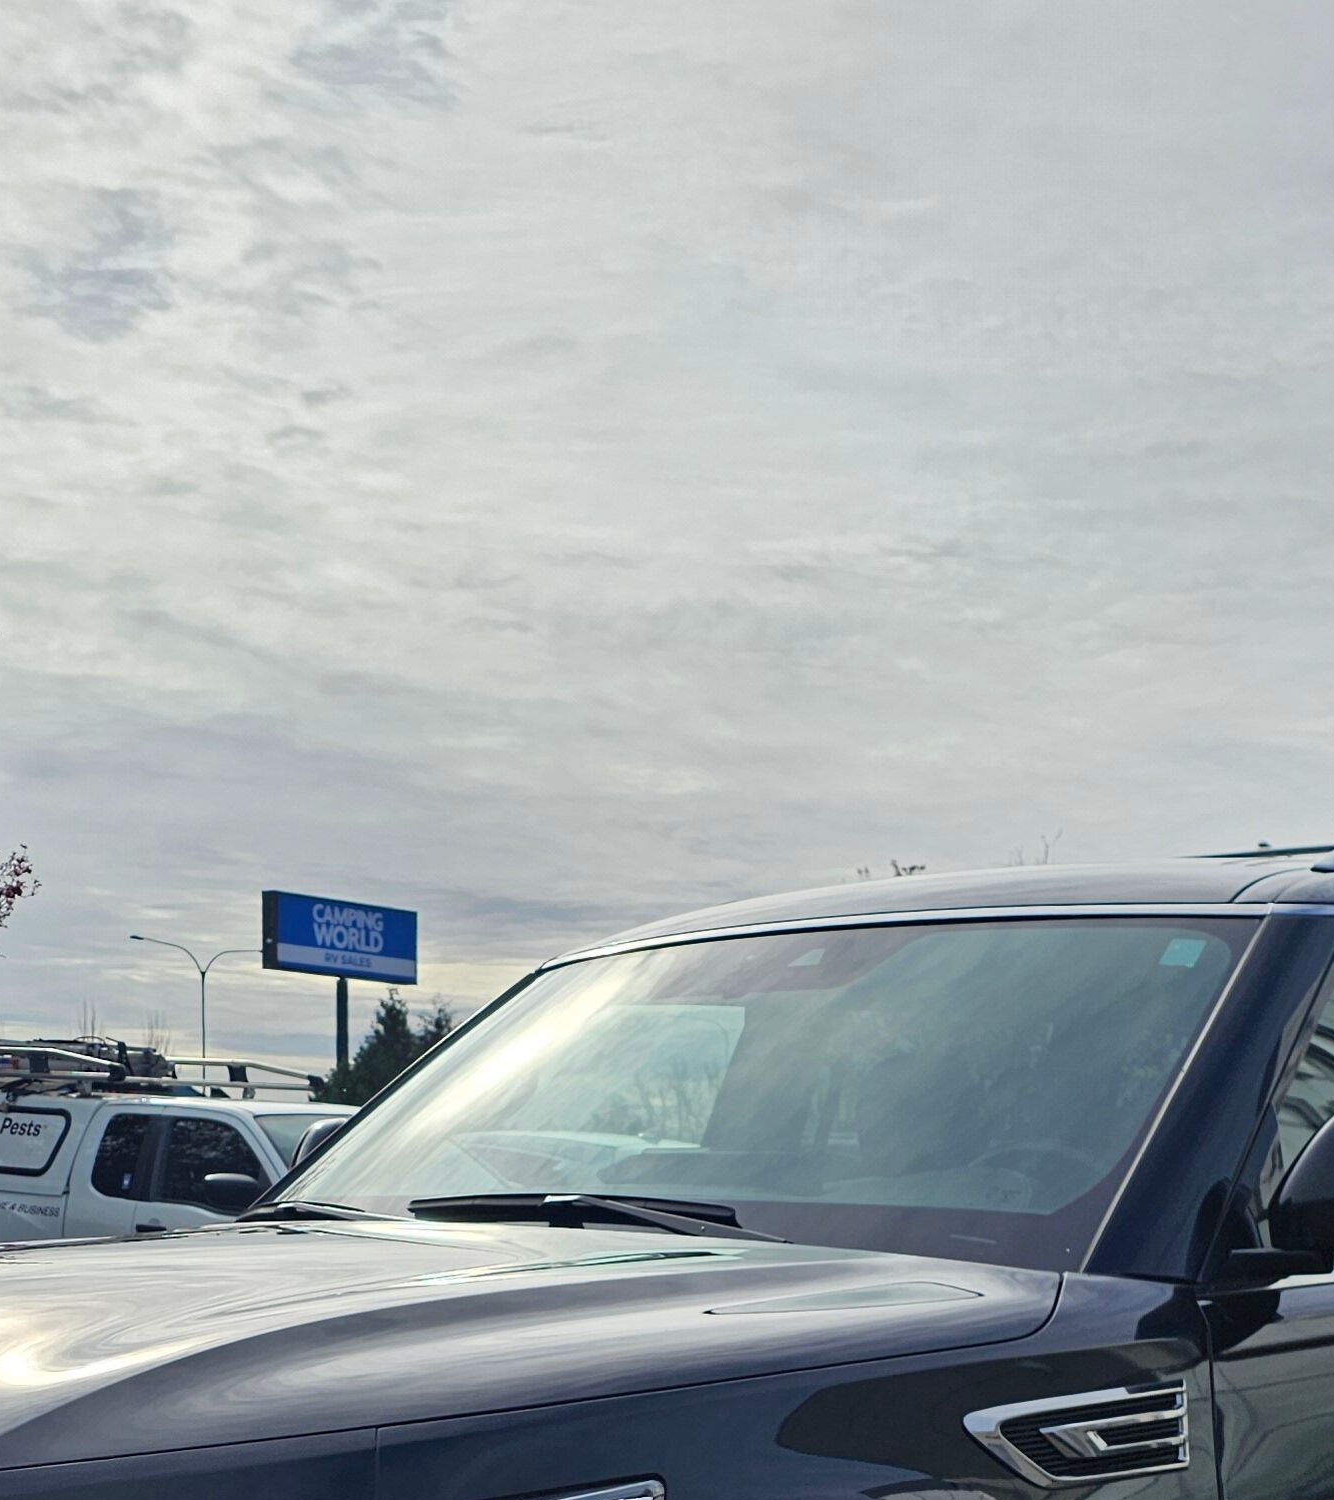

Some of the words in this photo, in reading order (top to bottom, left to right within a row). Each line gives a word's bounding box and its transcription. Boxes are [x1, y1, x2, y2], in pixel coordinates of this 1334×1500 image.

[312, 903, 383, 931] CAMPING
[312, 922, 384, 953] WORLD
[325, 953, 338, 963] RV
[341, 955, 371, 968] SALES
[0, 1117, 42, 1137] Pests
[17, 1203, 60, 1218] BUSINESS
